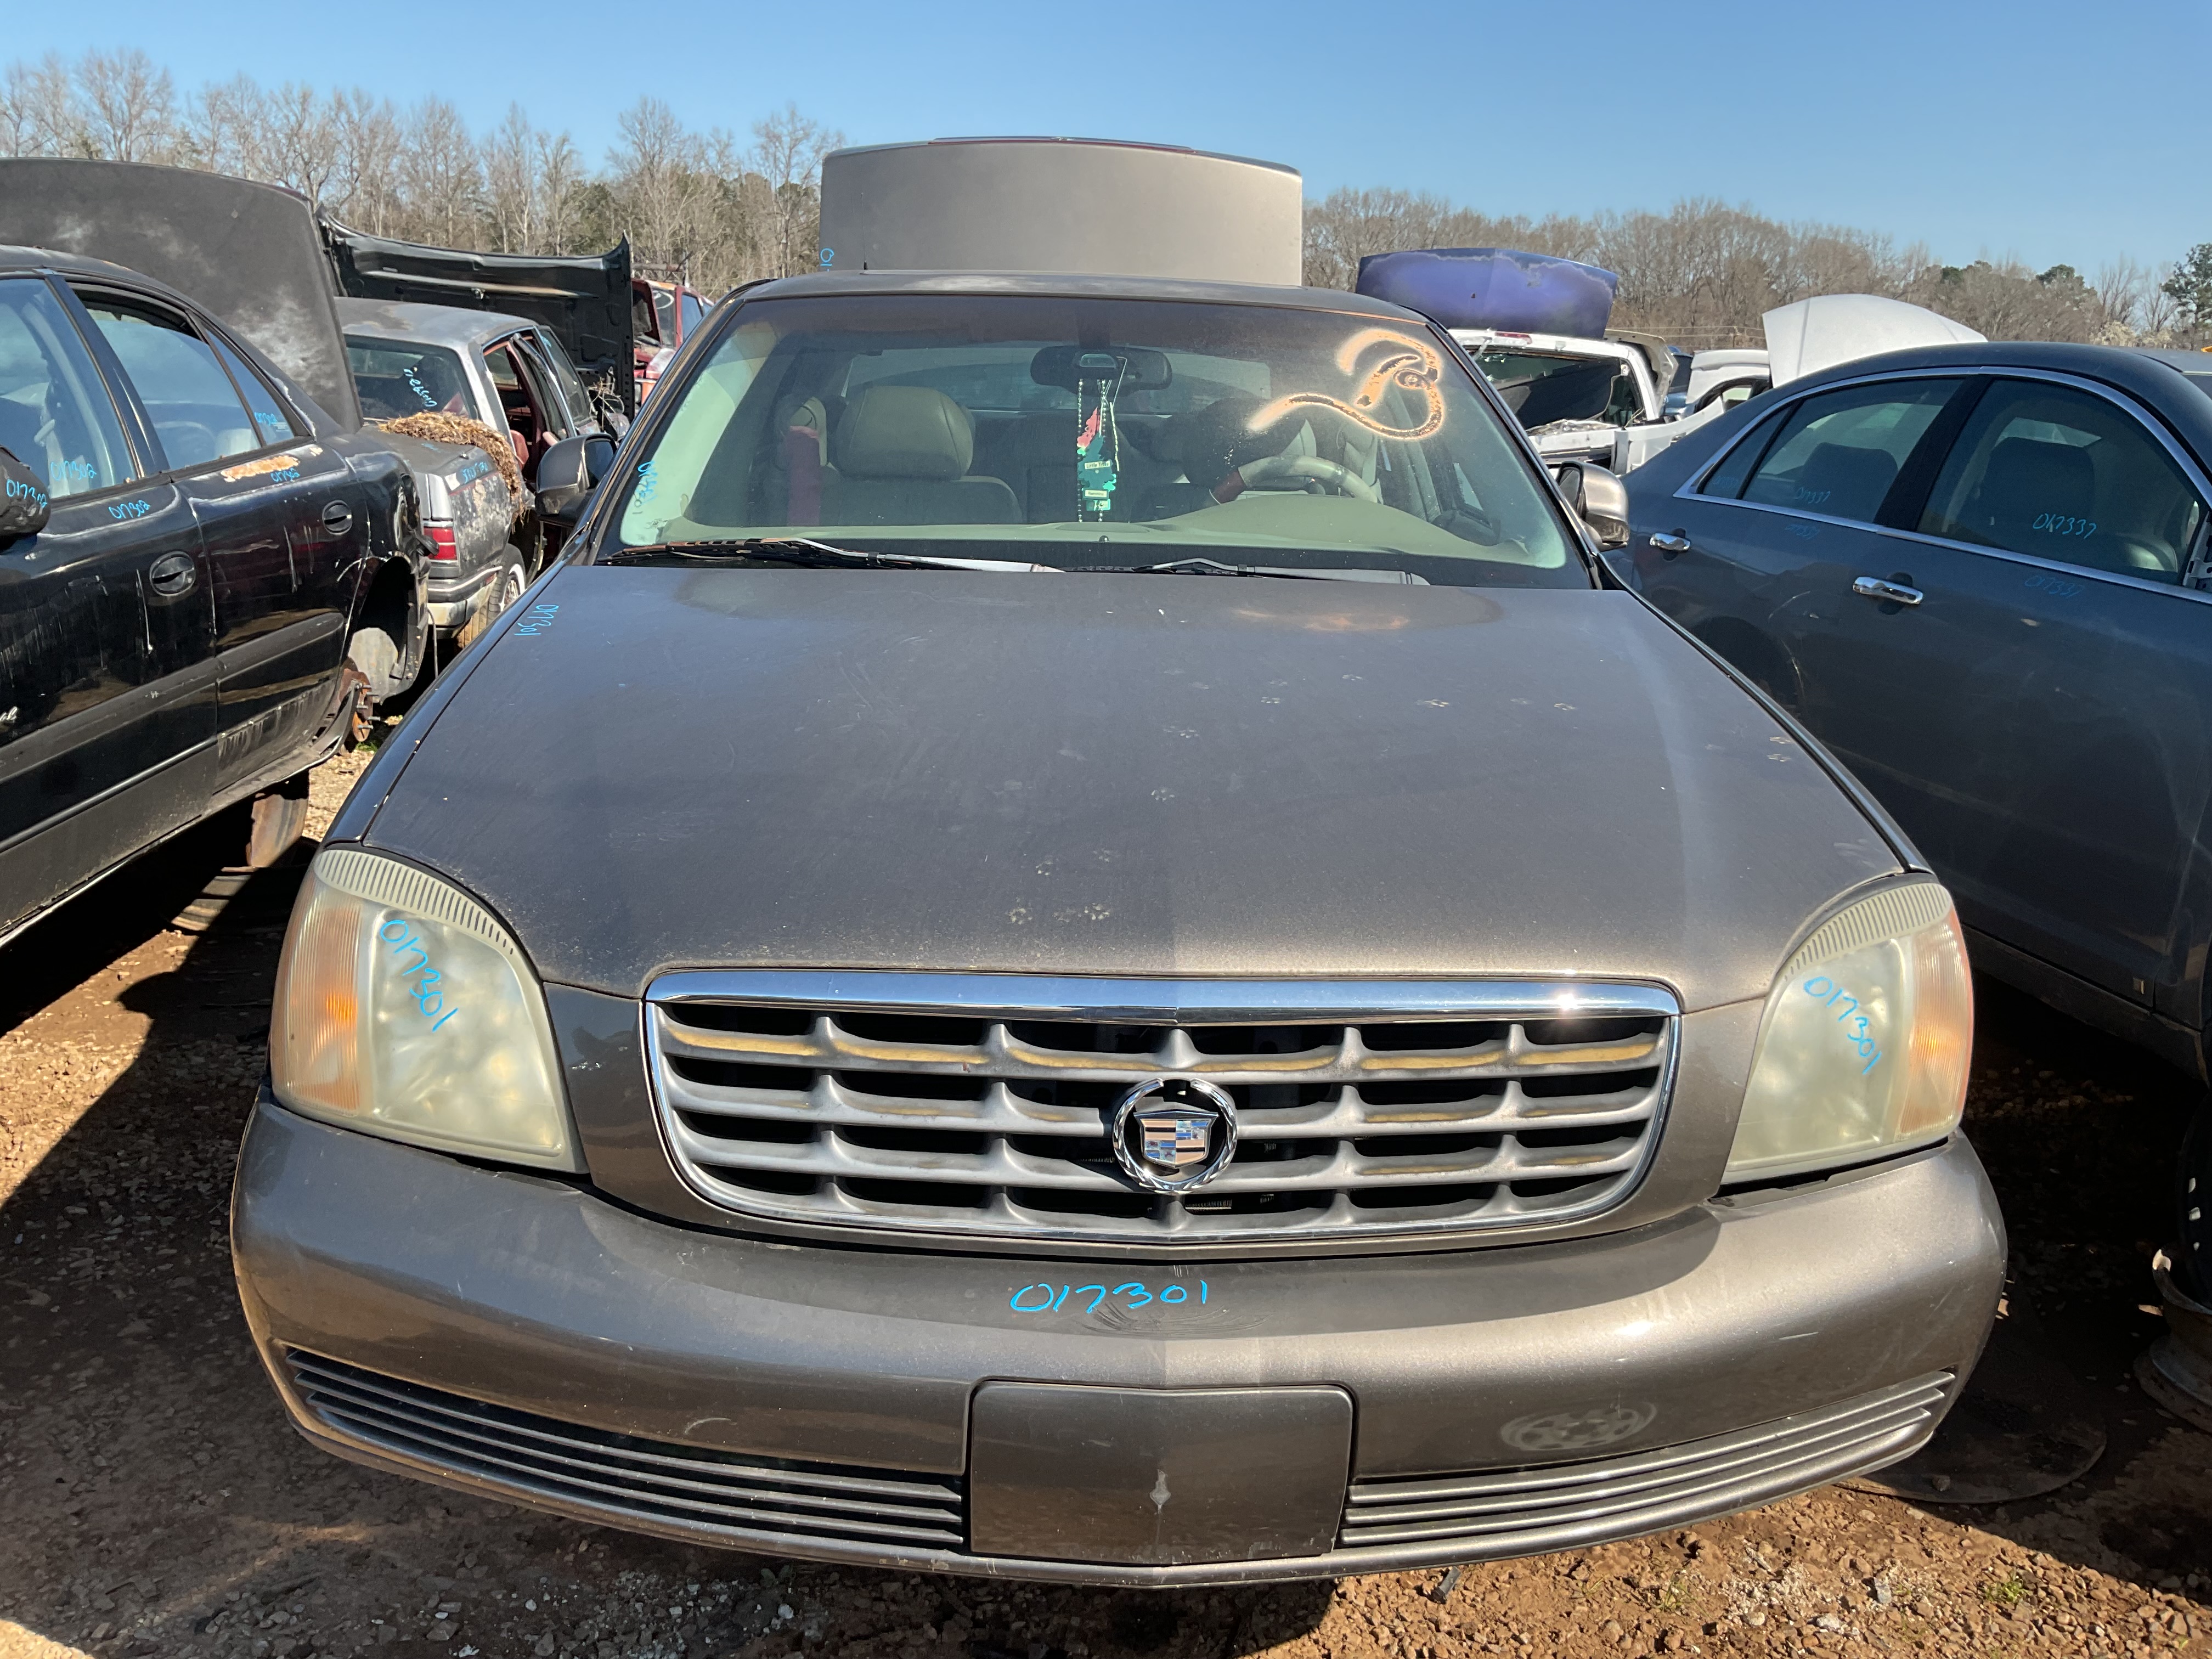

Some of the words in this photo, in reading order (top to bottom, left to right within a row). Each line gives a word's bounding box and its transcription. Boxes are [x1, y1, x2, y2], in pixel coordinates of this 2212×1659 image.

[820, 247, 834, 272] 01
[50, 460, 97, 481] 017302
[108, 500, 151, 519] 017302
[2032, 512, 2097, 539] 017337
[514, 604, 559, 636] 017301
[380, 919, 458, 1032] 017301
[1803, 976, 1882, 1075] 017301
[1009, 1279, 1207, 1314] 017301
